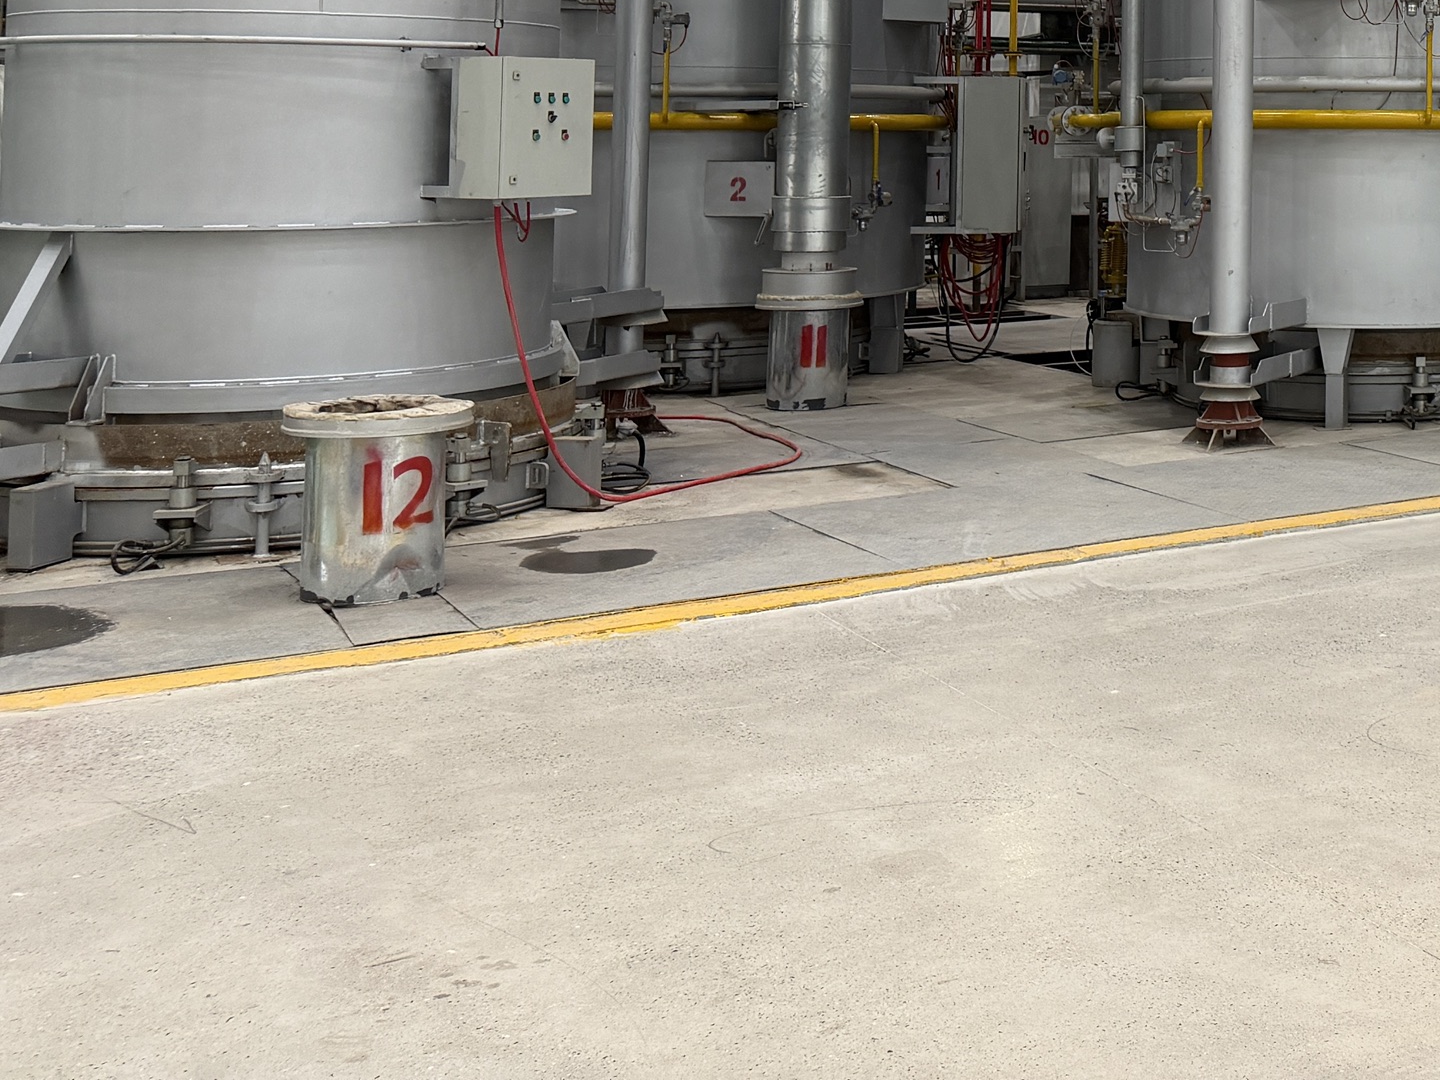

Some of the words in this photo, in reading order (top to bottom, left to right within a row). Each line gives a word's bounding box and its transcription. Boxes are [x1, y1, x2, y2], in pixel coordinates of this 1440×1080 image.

[730, 177, 746, 201] 2
[801, 325, 827, 368] 11
[363, 456, 434, 535] 12
